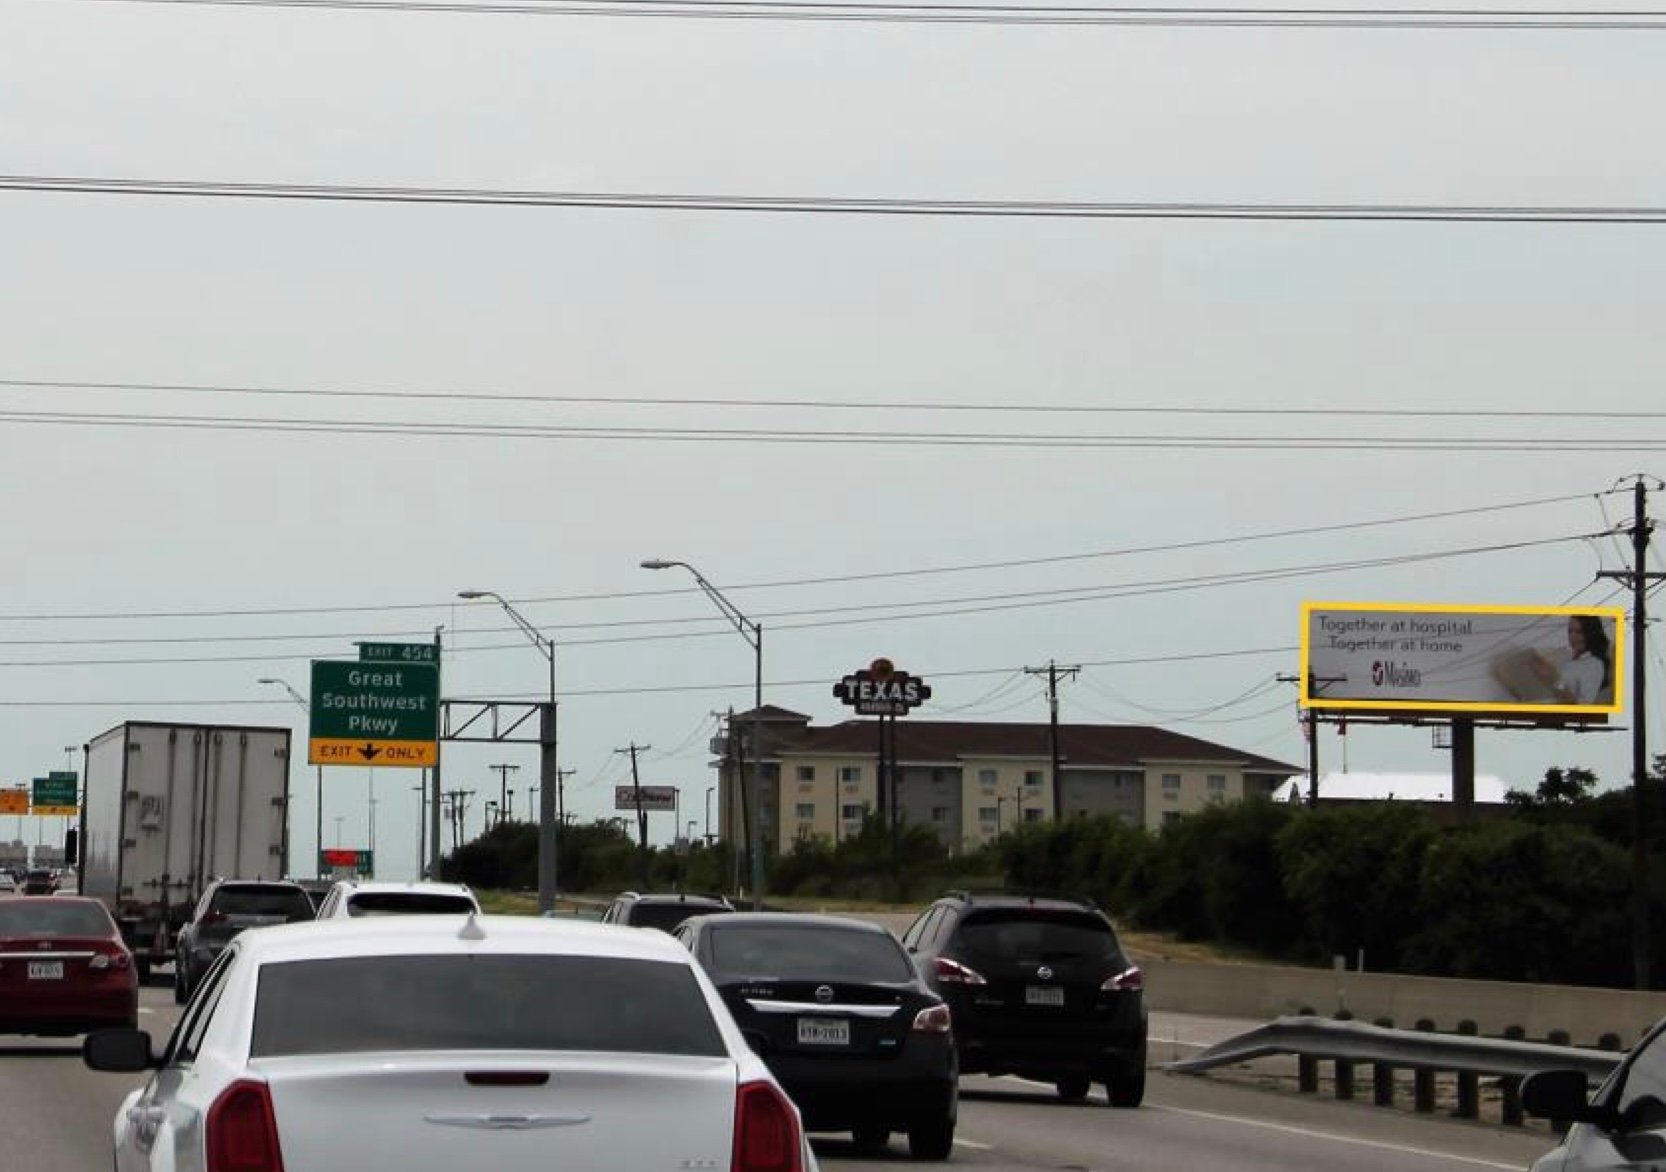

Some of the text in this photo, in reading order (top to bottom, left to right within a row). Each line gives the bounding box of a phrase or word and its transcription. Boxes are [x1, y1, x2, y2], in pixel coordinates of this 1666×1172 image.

[1318, 615, 1473, 636] Together at hospital
[1328, 635, 1463, 652] Together at home
[367, 646, 433, 661] EXIT 454
[348, 670, 403, 687] Great
[843, 680, 919, 702] TEXAS
[321, 692, 427, 711] Southwest
[348, 715, 398, 735] Pkwy
[320, 745, 425, 759] EXIT ONLY
